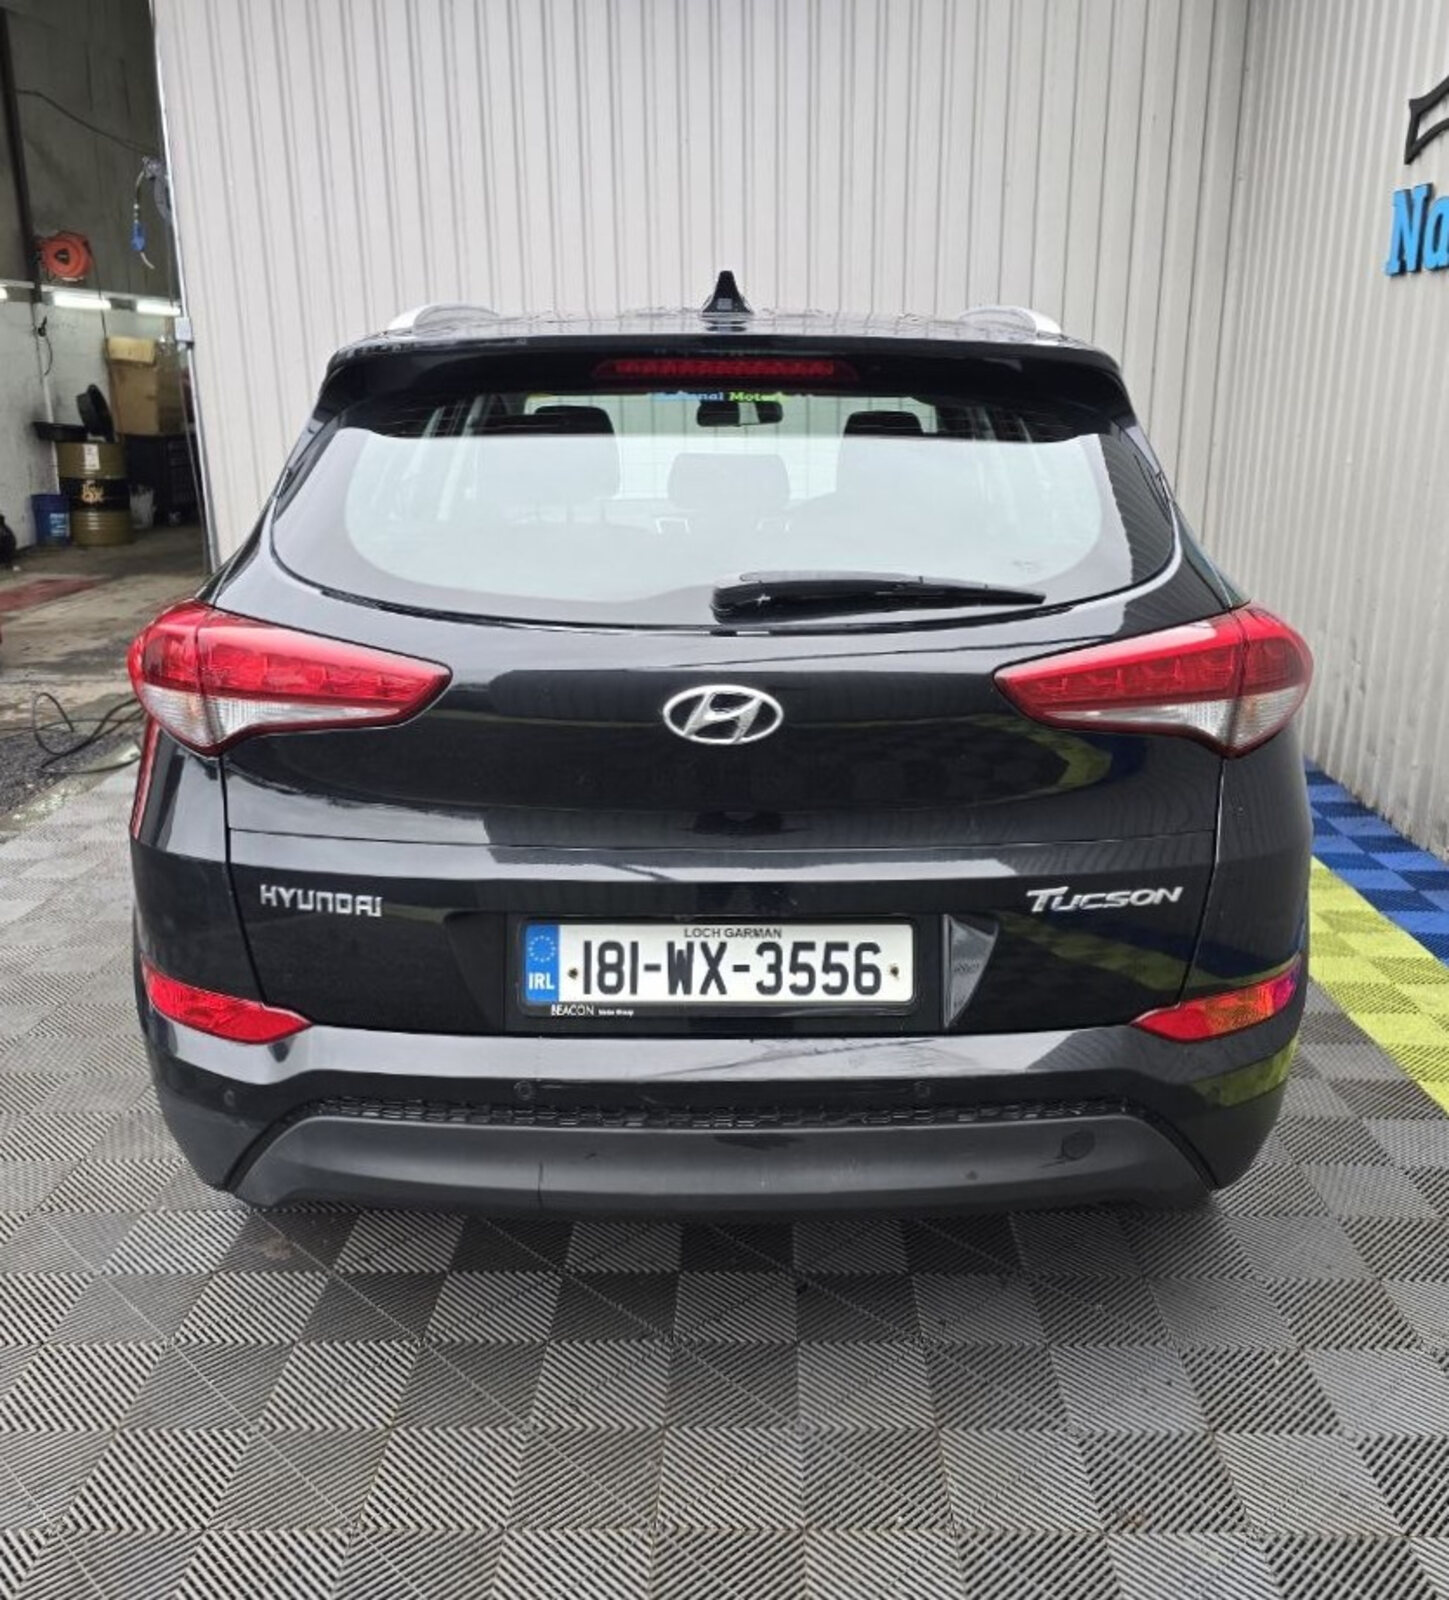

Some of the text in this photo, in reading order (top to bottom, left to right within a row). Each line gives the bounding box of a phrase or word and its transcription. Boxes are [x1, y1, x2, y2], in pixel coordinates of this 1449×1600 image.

[260, 884, 382, 917] HYUNDAI
[684, 928, 782, 938] LOCH GARMAN
[583, 940, 882, 995] 181-WX-3556
[528, 972, 555, 990] IRL
[551, 1004, 594, 1016] BEACON
